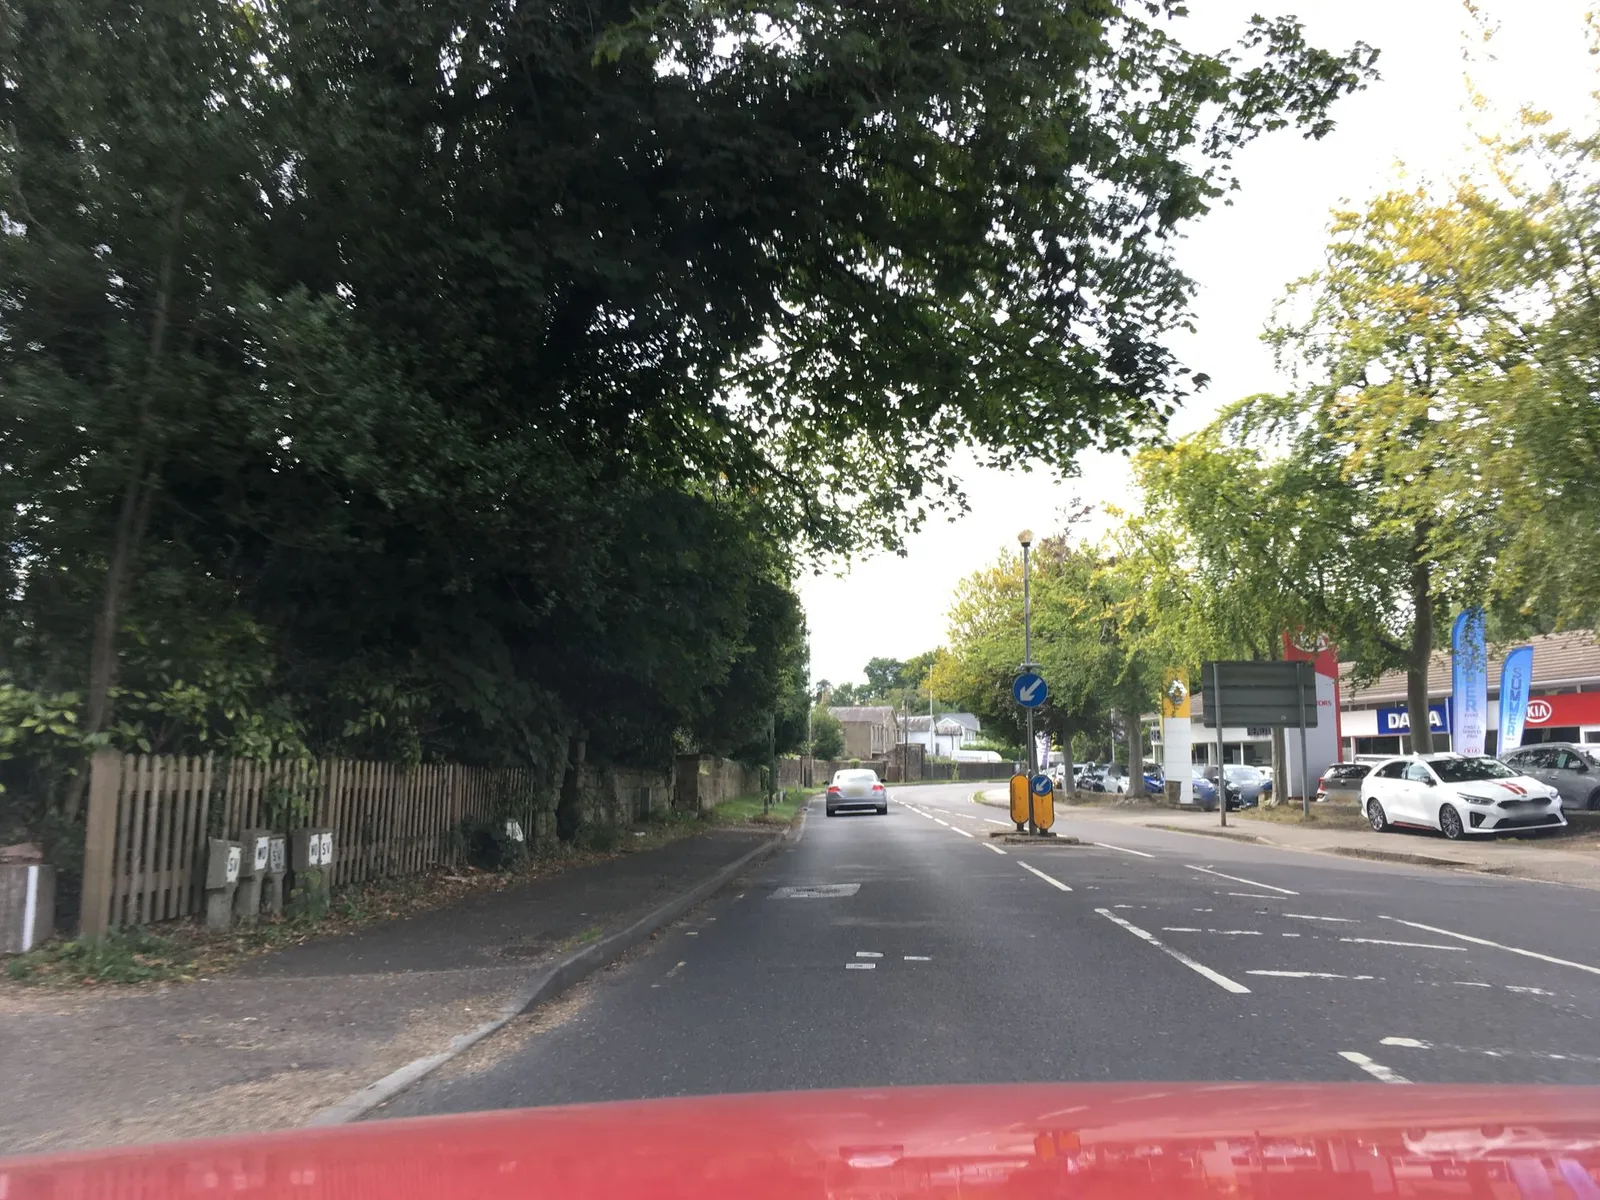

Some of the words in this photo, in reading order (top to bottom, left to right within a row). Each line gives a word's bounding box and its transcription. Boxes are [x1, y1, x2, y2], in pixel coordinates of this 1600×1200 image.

[1507, 667, 1522, 737] SUMMER
[1527, 705, 1547, 717] KIA
[1387, 711, 1442, 729] DAA
